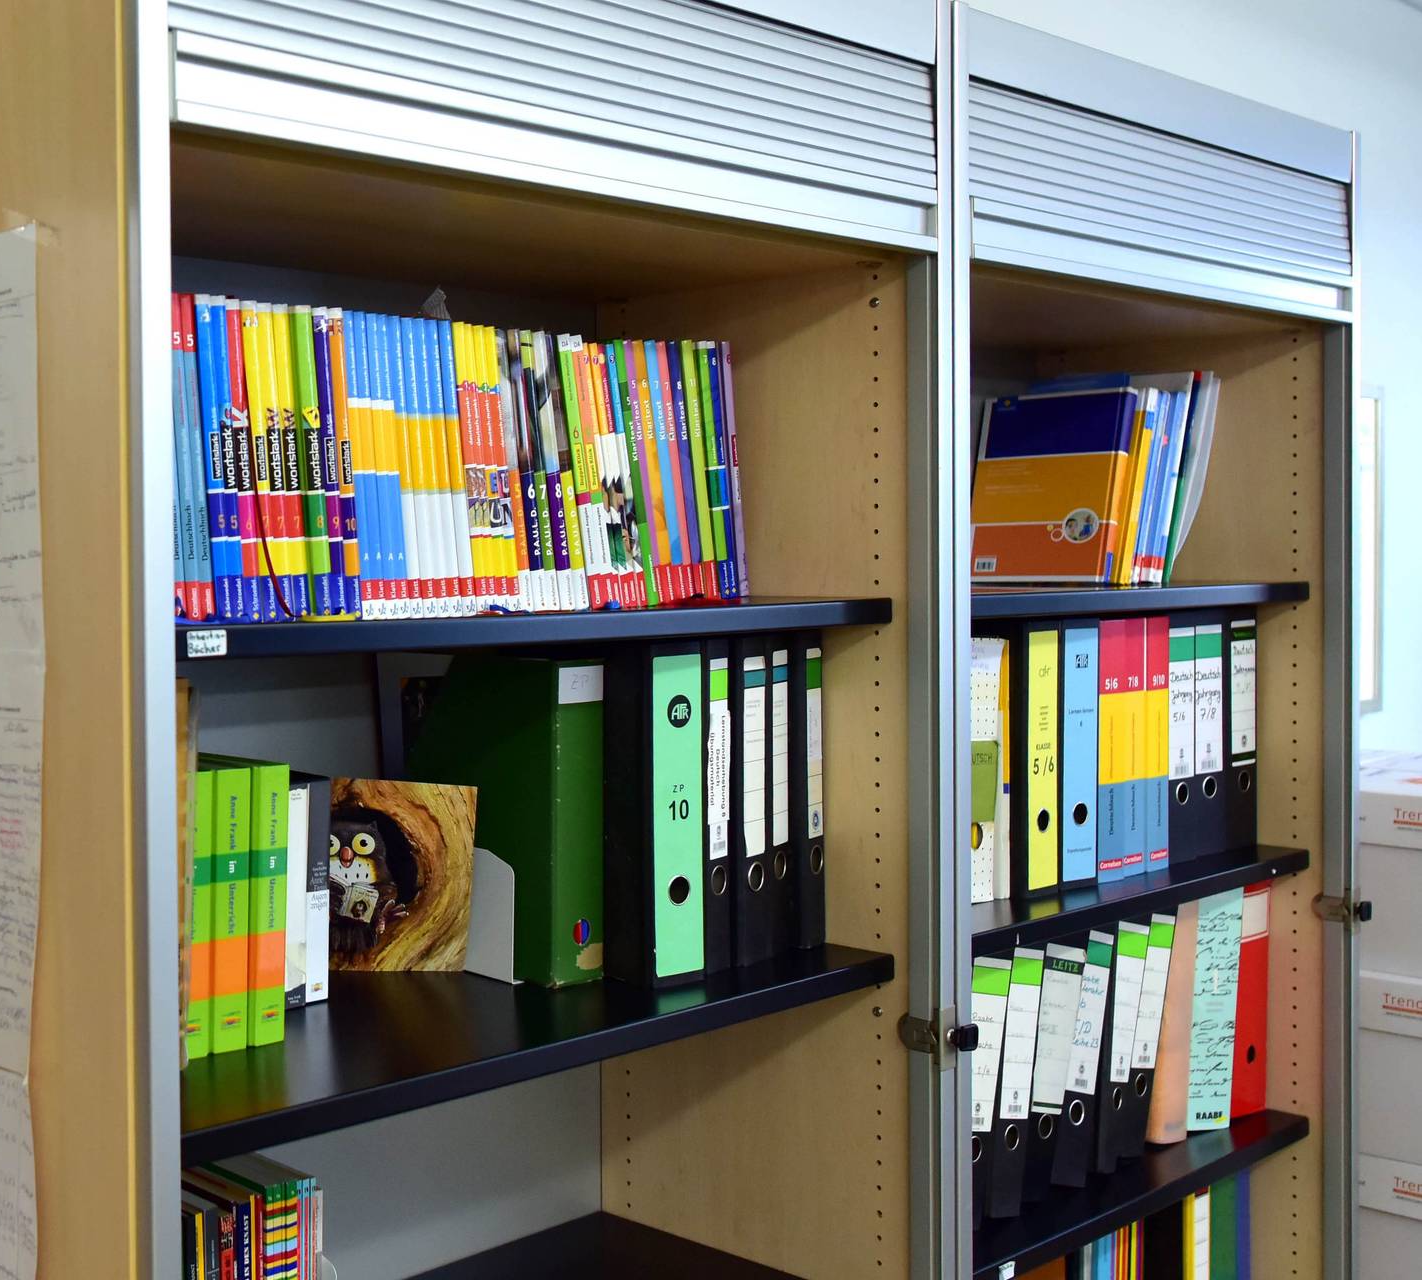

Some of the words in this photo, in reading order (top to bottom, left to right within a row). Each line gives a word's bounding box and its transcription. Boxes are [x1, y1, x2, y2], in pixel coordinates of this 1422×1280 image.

[173, 332, 181, 344] 5
[186, 334, 194, 347] 5
[632, 380, 636, 388] 5
[642, 379, 647, 388] 6
[664, 382, 670, 390] 7
[677, 381, 682, 390] 8
[223, 428, 236, 487] wortstark
[238, 430, 250, 489] wortstark
[270, 430, 282, 489] wortstark
[286, 430, 299, 489] wortstark
[308, 430, 322, 489] wortstark
[327, 438, 337, 482] wortstark
[342, 442, 353, 484] wortstark
[528, 484, 536, 498] 6
[540, 485, 546, 499] 7
[555, 484, 562, 498] 8
[566, 486, 574, 499] 9
[218, 514, 226, 528] 5
[230, 515, 238, 529] 5
[278, 516, 285, 529] 7
[294, 515, 301, 528] 7
[316, 515, 324, 528] 8
[332, 515, 340, 529] 9
[346, 517, 356, 531] 10
[184, 504, 195, 560] Deutschbuch
[236, 577, 244, 611] Schroedel
[300, 574, 308, 609] Schroedel
[1170, 671, 1194, 683] Deutsch
[1195, 667, 1221, 681] Deutsch
[1195, 690, 1220, 705] Jahrgang
[1173, 711, 1186, 722] 5/6
[1200, 706, 1217, 720] 7/8
[1033, 758, 1040, 775] 5
[230, 796, 238, 820] Anne
[668, 799, 689, 820] 10
[229, 860, 237, 874] im
[270, 856, 276, 868] im
[1052, 959, 1079, 973] LEITZ
